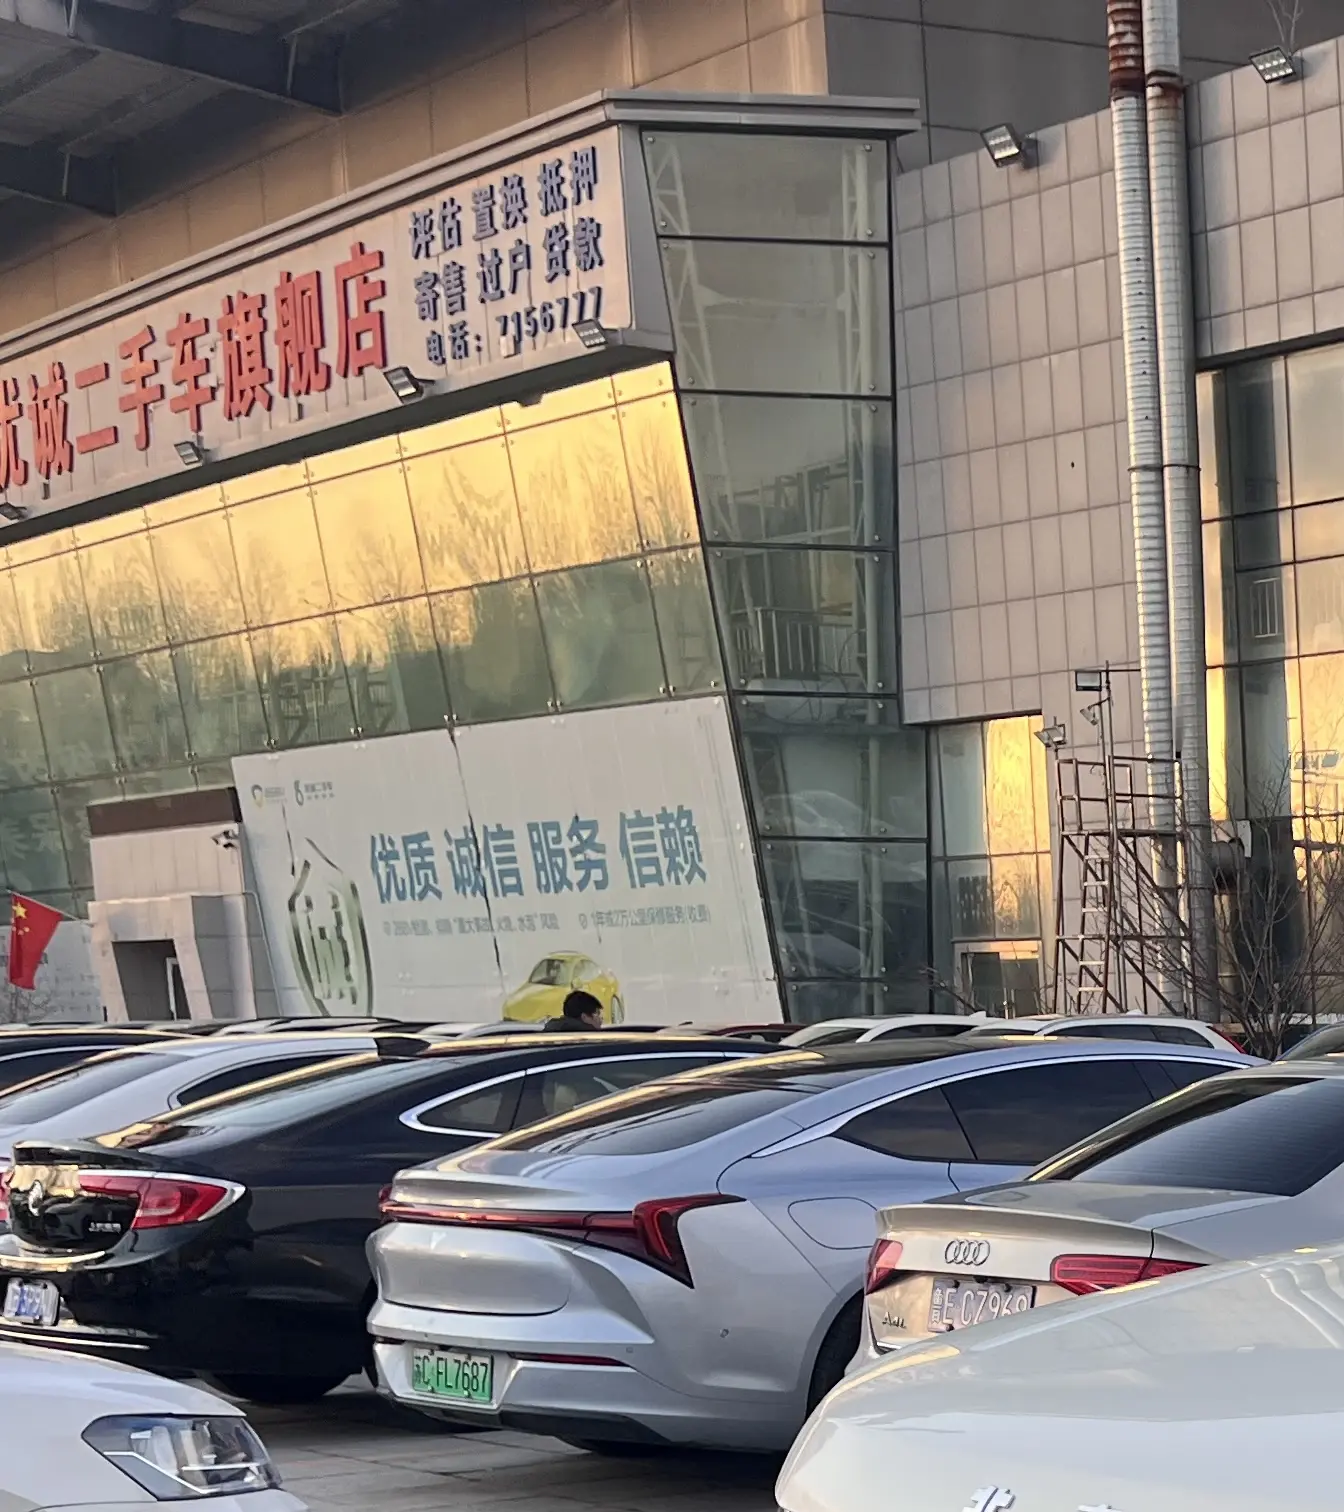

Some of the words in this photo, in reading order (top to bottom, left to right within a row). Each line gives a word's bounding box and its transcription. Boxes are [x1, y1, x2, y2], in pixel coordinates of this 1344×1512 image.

[409, 197, 462, 260] 评估
[472, 173, 528, 241] 置换
[538, 146, 598, 217] 抵押
[414, 261, 466, 321] 寄售
[477, 238, 531, 304] 过户
[543, 216, 604, 283] 贷款
[369, 831, 443, 904] 优质
[444, 823, 524, 899] 诚信
[528, 813, 607, 894] 服务
[619, 804, 708, 889] 信赖
